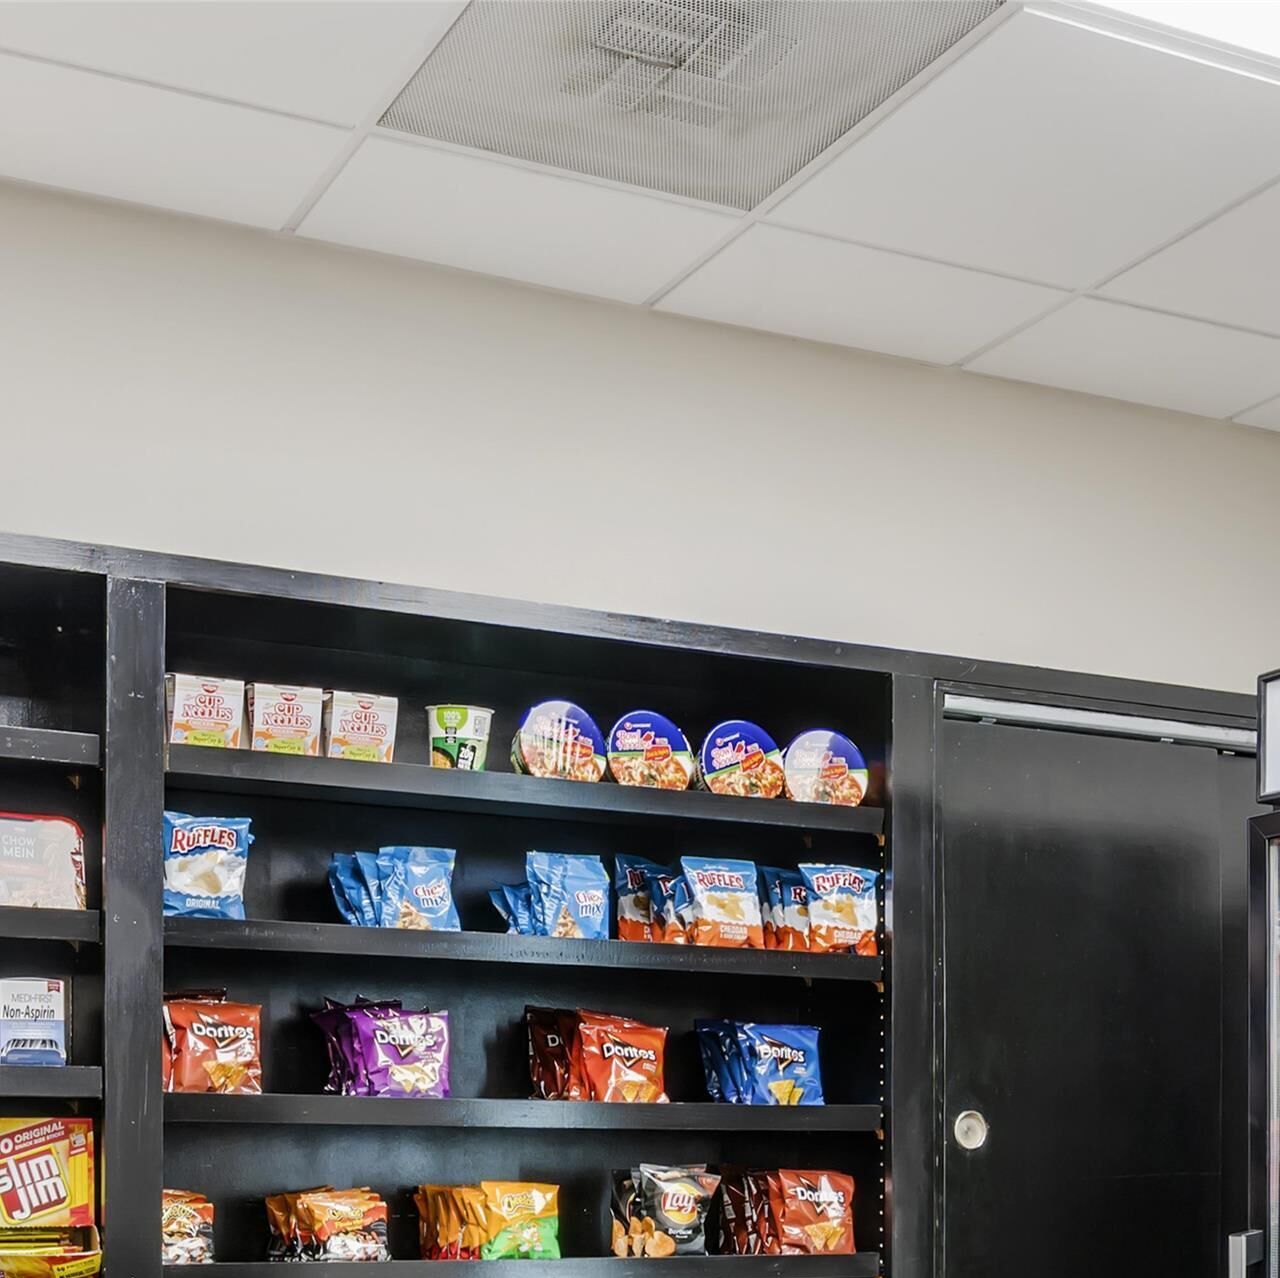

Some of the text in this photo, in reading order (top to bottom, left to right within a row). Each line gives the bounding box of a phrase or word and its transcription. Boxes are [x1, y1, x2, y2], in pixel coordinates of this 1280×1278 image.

[195, 695, 224, 707] CUP
[274, 703, 303, 715] CUP
[182, 705, 233, 721] NOODLES
[262, 713, 312, 729] NOODLES
[351, 712, 379, 724] CUP
[339, 720, 387, 737] NOODLES
[1, 834, 36, 848] CHOW
[171, 826, 237, 853] RUFFLES
[2, 845, 35, 859] MEIN
[414, 880, 445, 897] Chex
[695, 870, 745, 890] RUFFLES
[813, 873, 865, 895] RUFFLES
[185, 897, 222, 909] ORIGINAL
[421, 891, 449, 910] mix
[575, 888, 603, 904] Chex
[578, 902, 604, 918] mix
[10, 993, 53, 1004] MEDI-FIRST
[2, 1004, 56, 1022] Non-Aspirin
[192, 1022, 255, 1041] Doritos
[376, 1029, 436, 1048] Doritos
[602, 1041, 657, 1062] Doritos
[756, 1044, 806, 1064] Doritos
[14, 1121, 65, 1144] ORIGINAL
